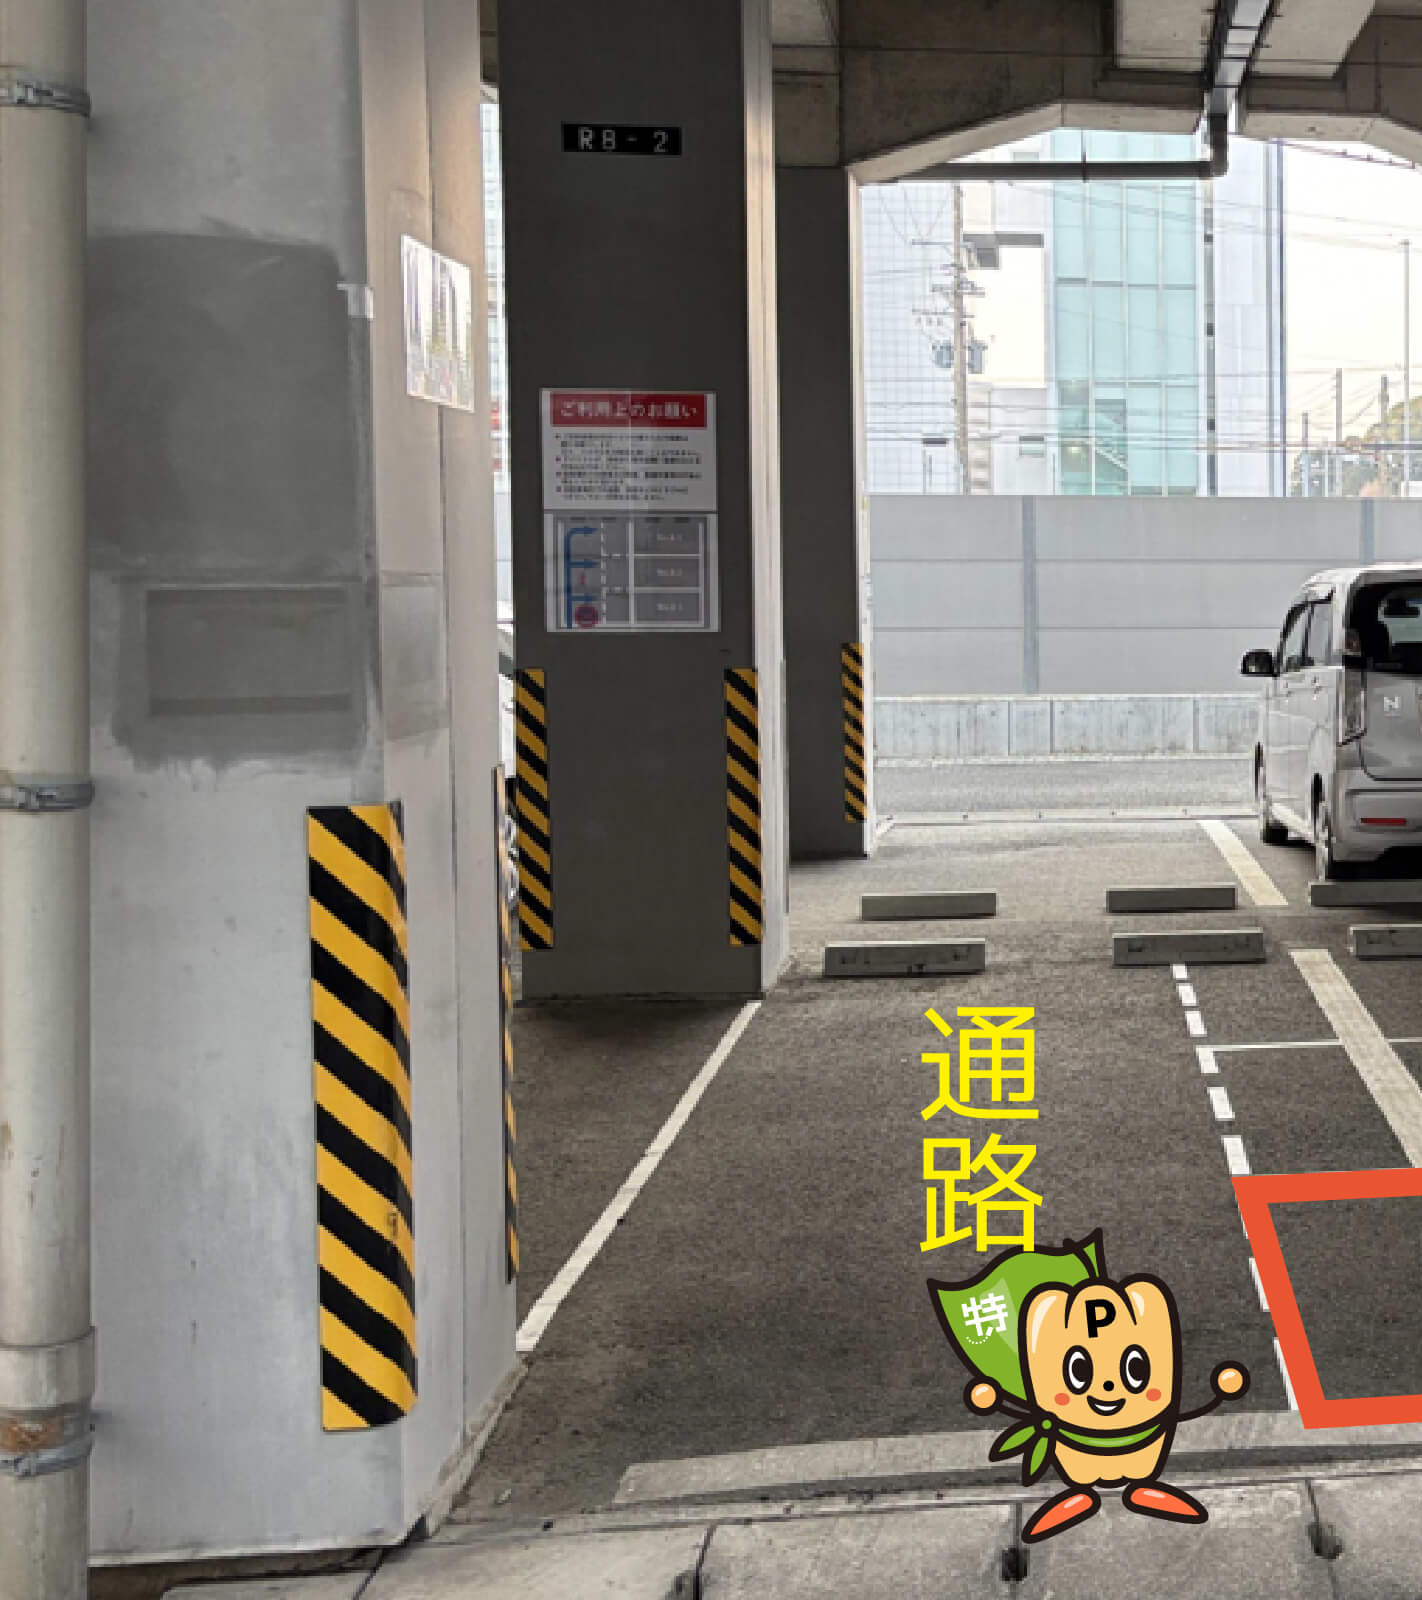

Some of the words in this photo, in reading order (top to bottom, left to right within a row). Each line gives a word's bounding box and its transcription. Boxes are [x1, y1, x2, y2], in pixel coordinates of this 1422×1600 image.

[561, 400, 698, 418] ご利用上のお願い
